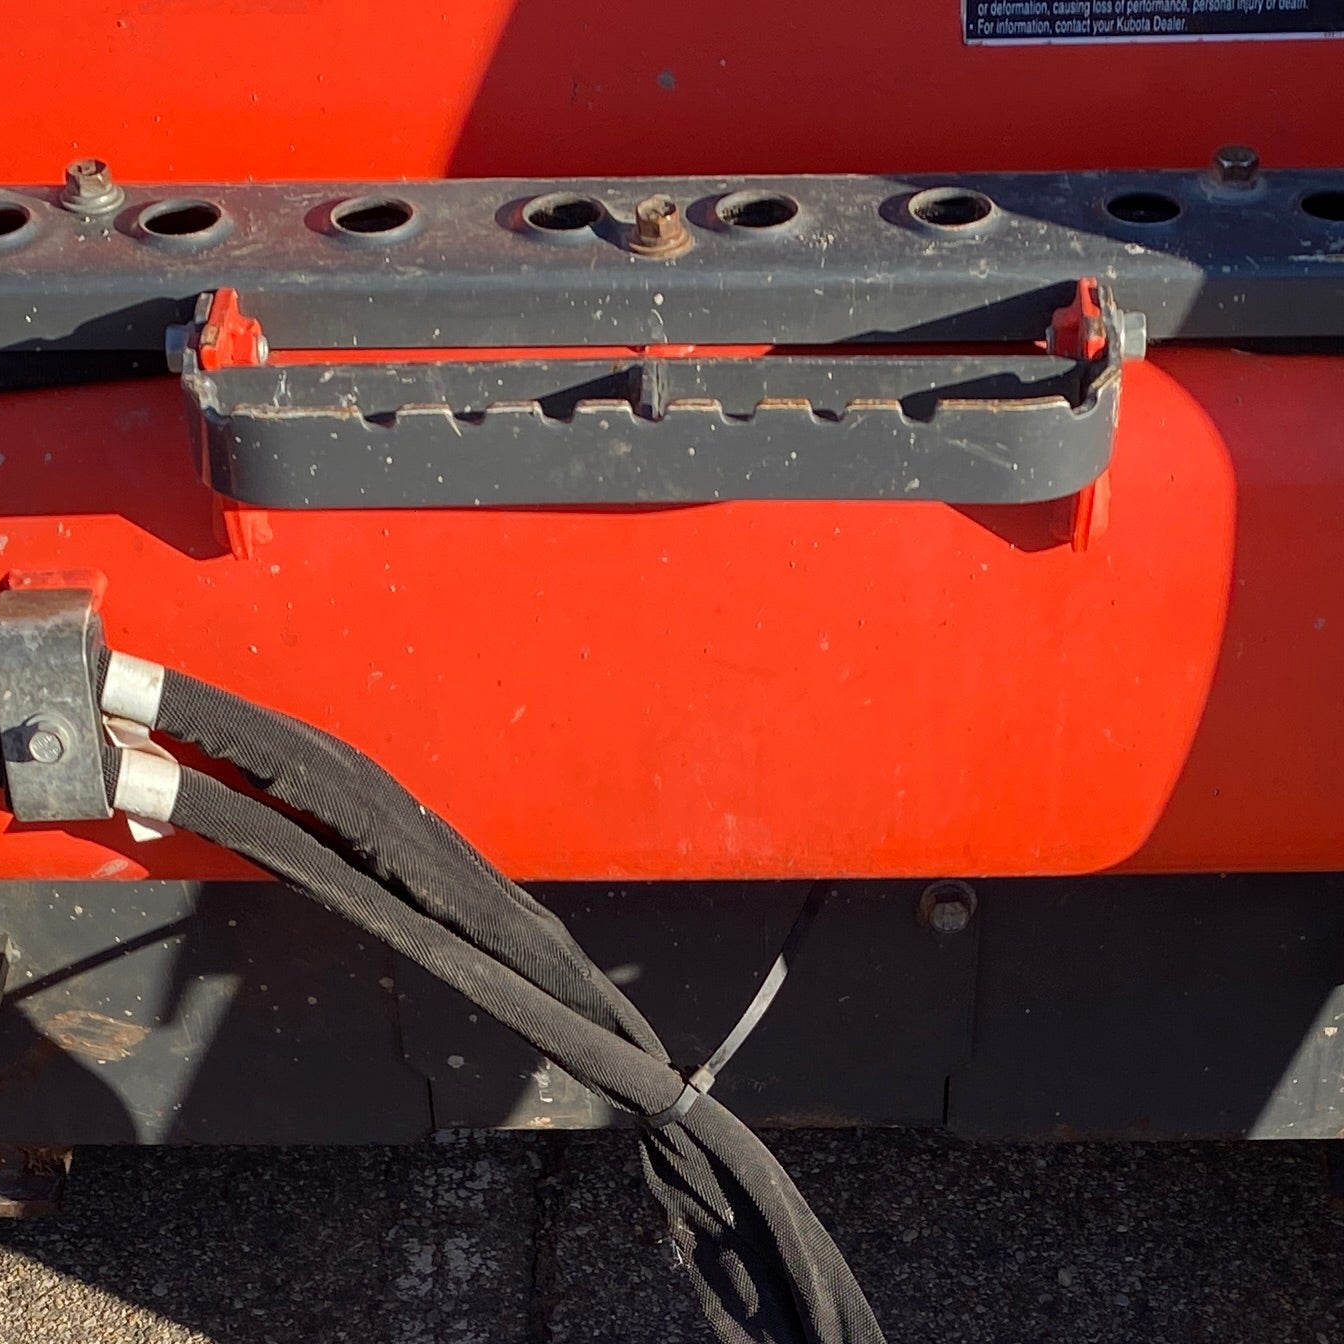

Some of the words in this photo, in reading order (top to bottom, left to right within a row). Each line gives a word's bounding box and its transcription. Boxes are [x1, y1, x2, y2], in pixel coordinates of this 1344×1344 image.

[978, 3, 988, 16] or
[990, 0, 1050, 16] deformation,
[1053, 0, 1090, 18] causing
[1093, 0, 1112, 14] loss
[1115, 0, 1125, 13] of
[1127, 0, 1190, 15] performance,
[1192, 0, 1235, 15] personal
[977, 18, 994, 34] For
[996, 18, 1052, 34] information,
[1055, 17, 1090, 33] contact
[1093, 19, 1115, 36] your
[1116, 16, 1150, 32] Kubota
[1153, 15, 1188, 31] Dealer.
